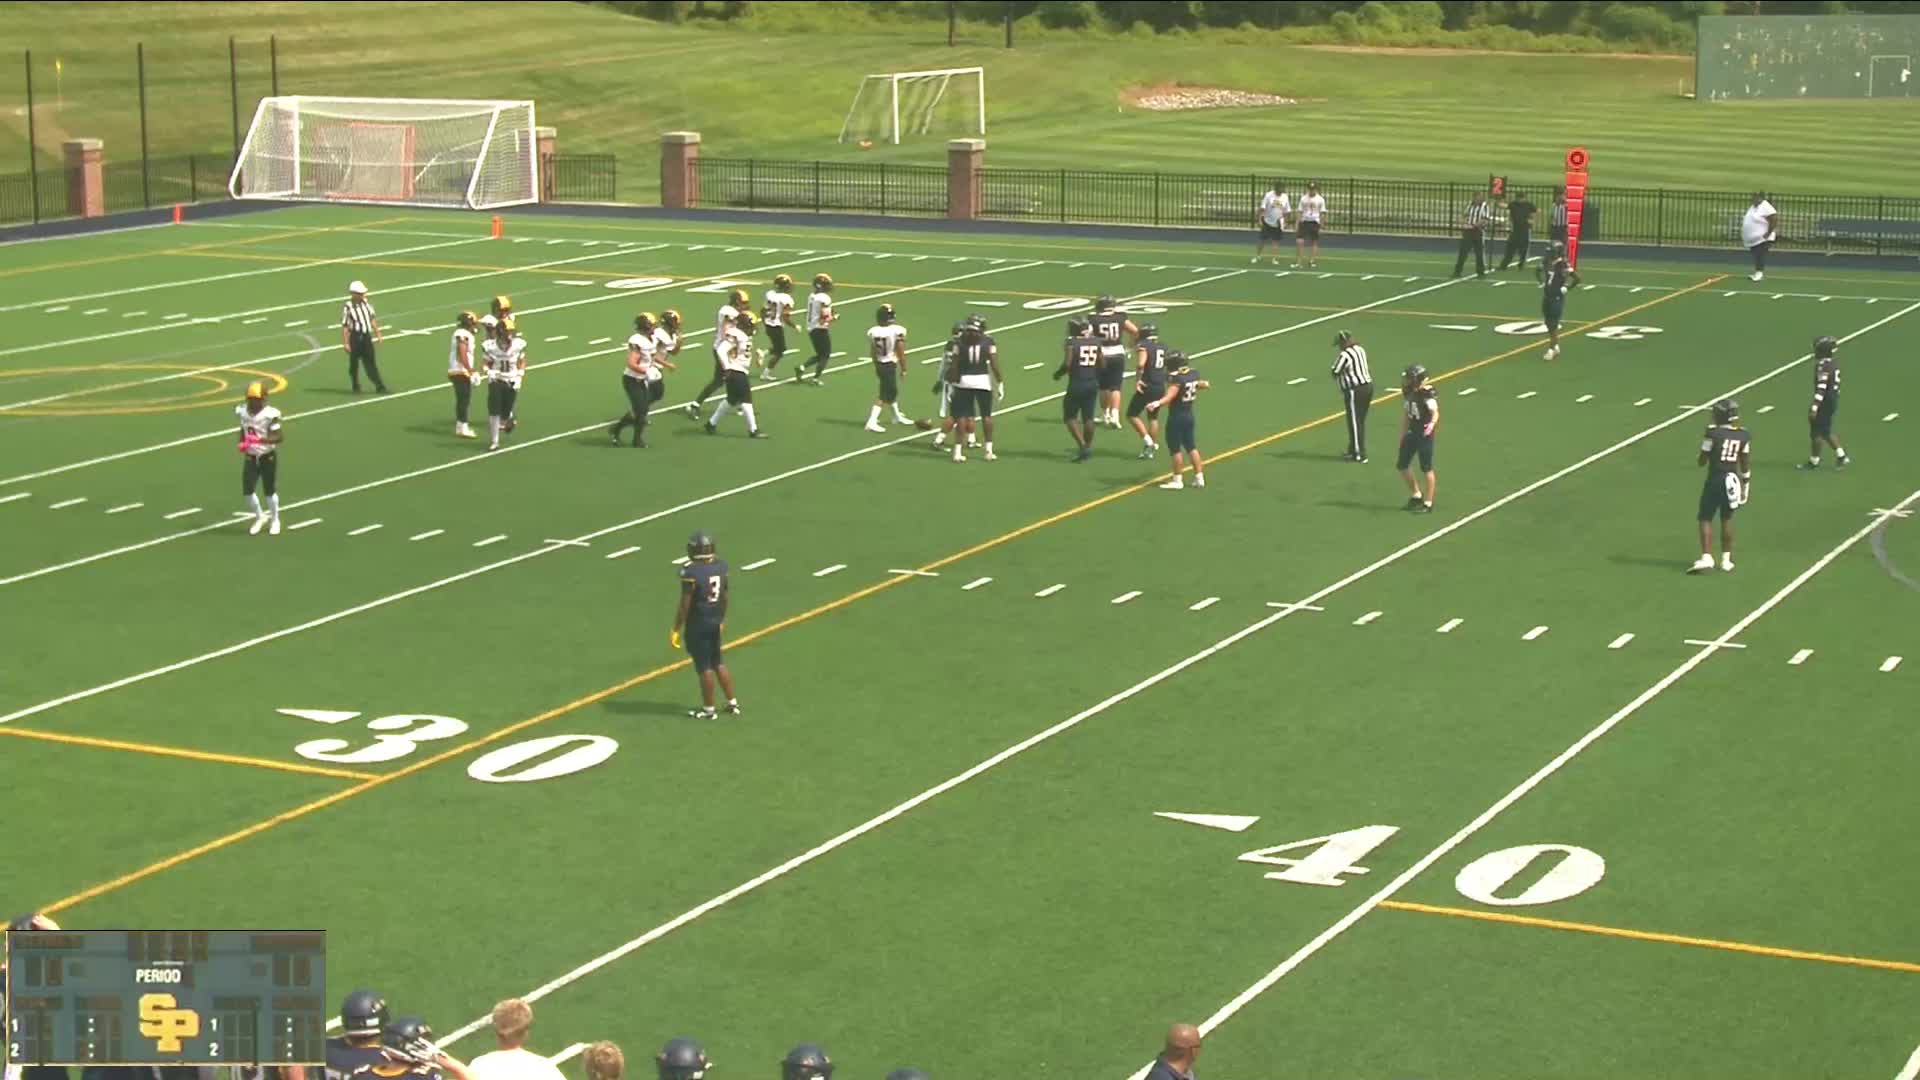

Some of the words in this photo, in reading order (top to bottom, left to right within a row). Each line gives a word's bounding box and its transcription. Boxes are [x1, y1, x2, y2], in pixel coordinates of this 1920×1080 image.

[1492, 176, 1503, 196] 2
[1099, 322, 1120, 339] 50
[968, 345, 981, 364] 11
[1079, 346, 1099, 366] 55
[1155, 350, 1165, 368] 6
[1720, 439, 1741, 462] 10
[707, 575, 721, 603] 3
[294, 714, 619, 783] 30
[1237, 824, 1606, 906] 40
